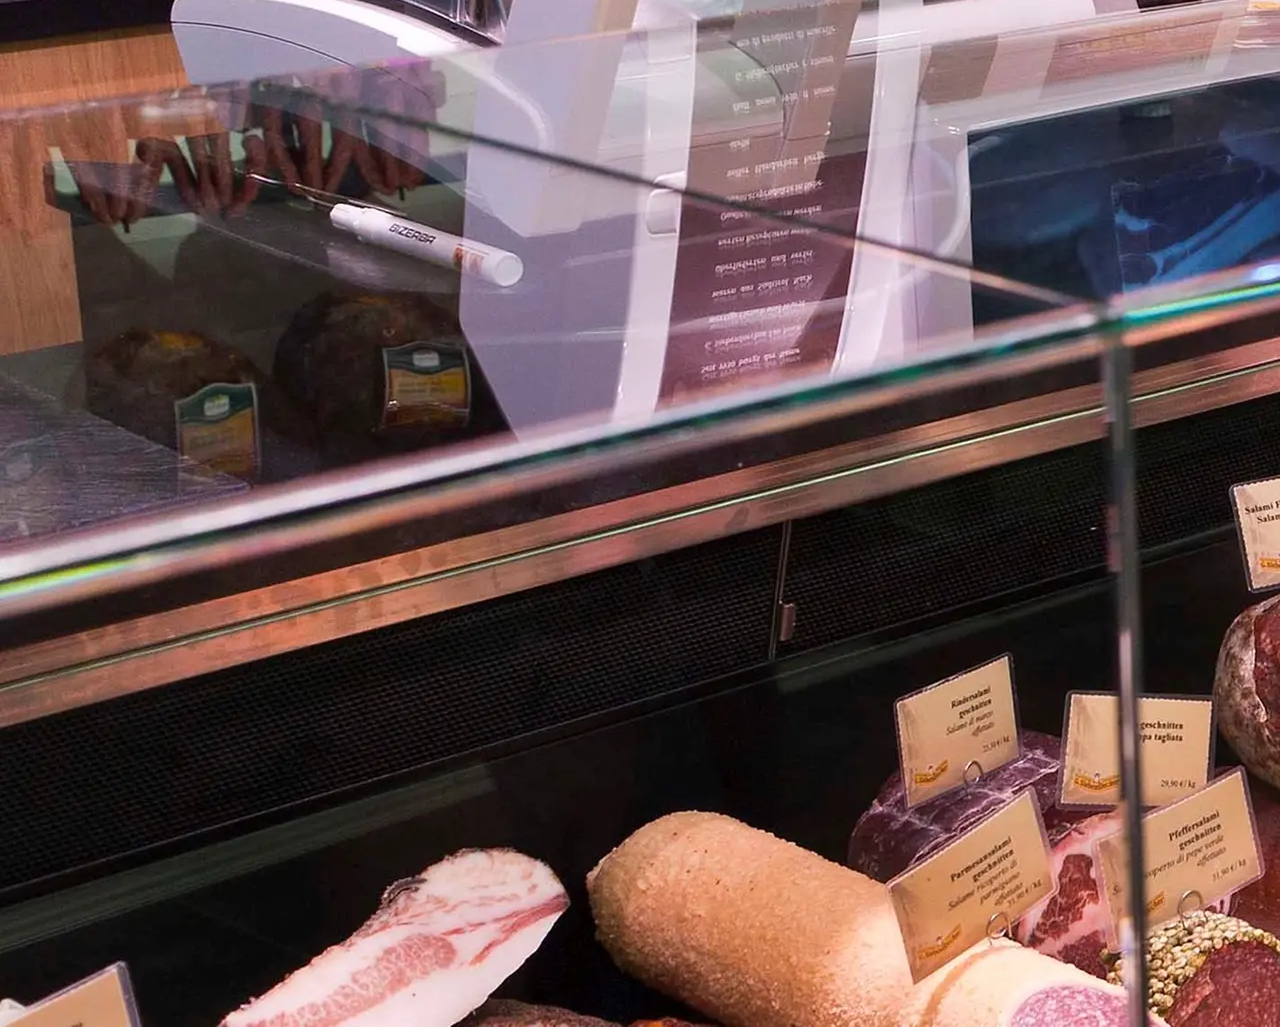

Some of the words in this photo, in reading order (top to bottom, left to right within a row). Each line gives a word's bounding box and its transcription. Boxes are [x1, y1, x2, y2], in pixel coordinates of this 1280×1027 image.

[389, 223, 437, 245] BIZERBA
[1245, 502, 1274, 515] Salami
[951, 686, 991, 709] Rindersalami
[959, 699, 992, 719] geschnitten
[1140, 721, 1184, 731] geschnitten
[1154, 733, 1183, 743] tagliata
[1188, 780, 1196, 789] kg
[1168, 810, 1220, 841] Pfeffersalami
[1179, 824, 1222, 850] geschnitten
[950, 836, 1012, 882] Parmesansalami
[1176, 855, 1185, 865] di
[1186, 843, 1204, 862] pepe
[1196, 846, 1227, 867] affettato
[972, 849, 1014, 882] geschnitten
